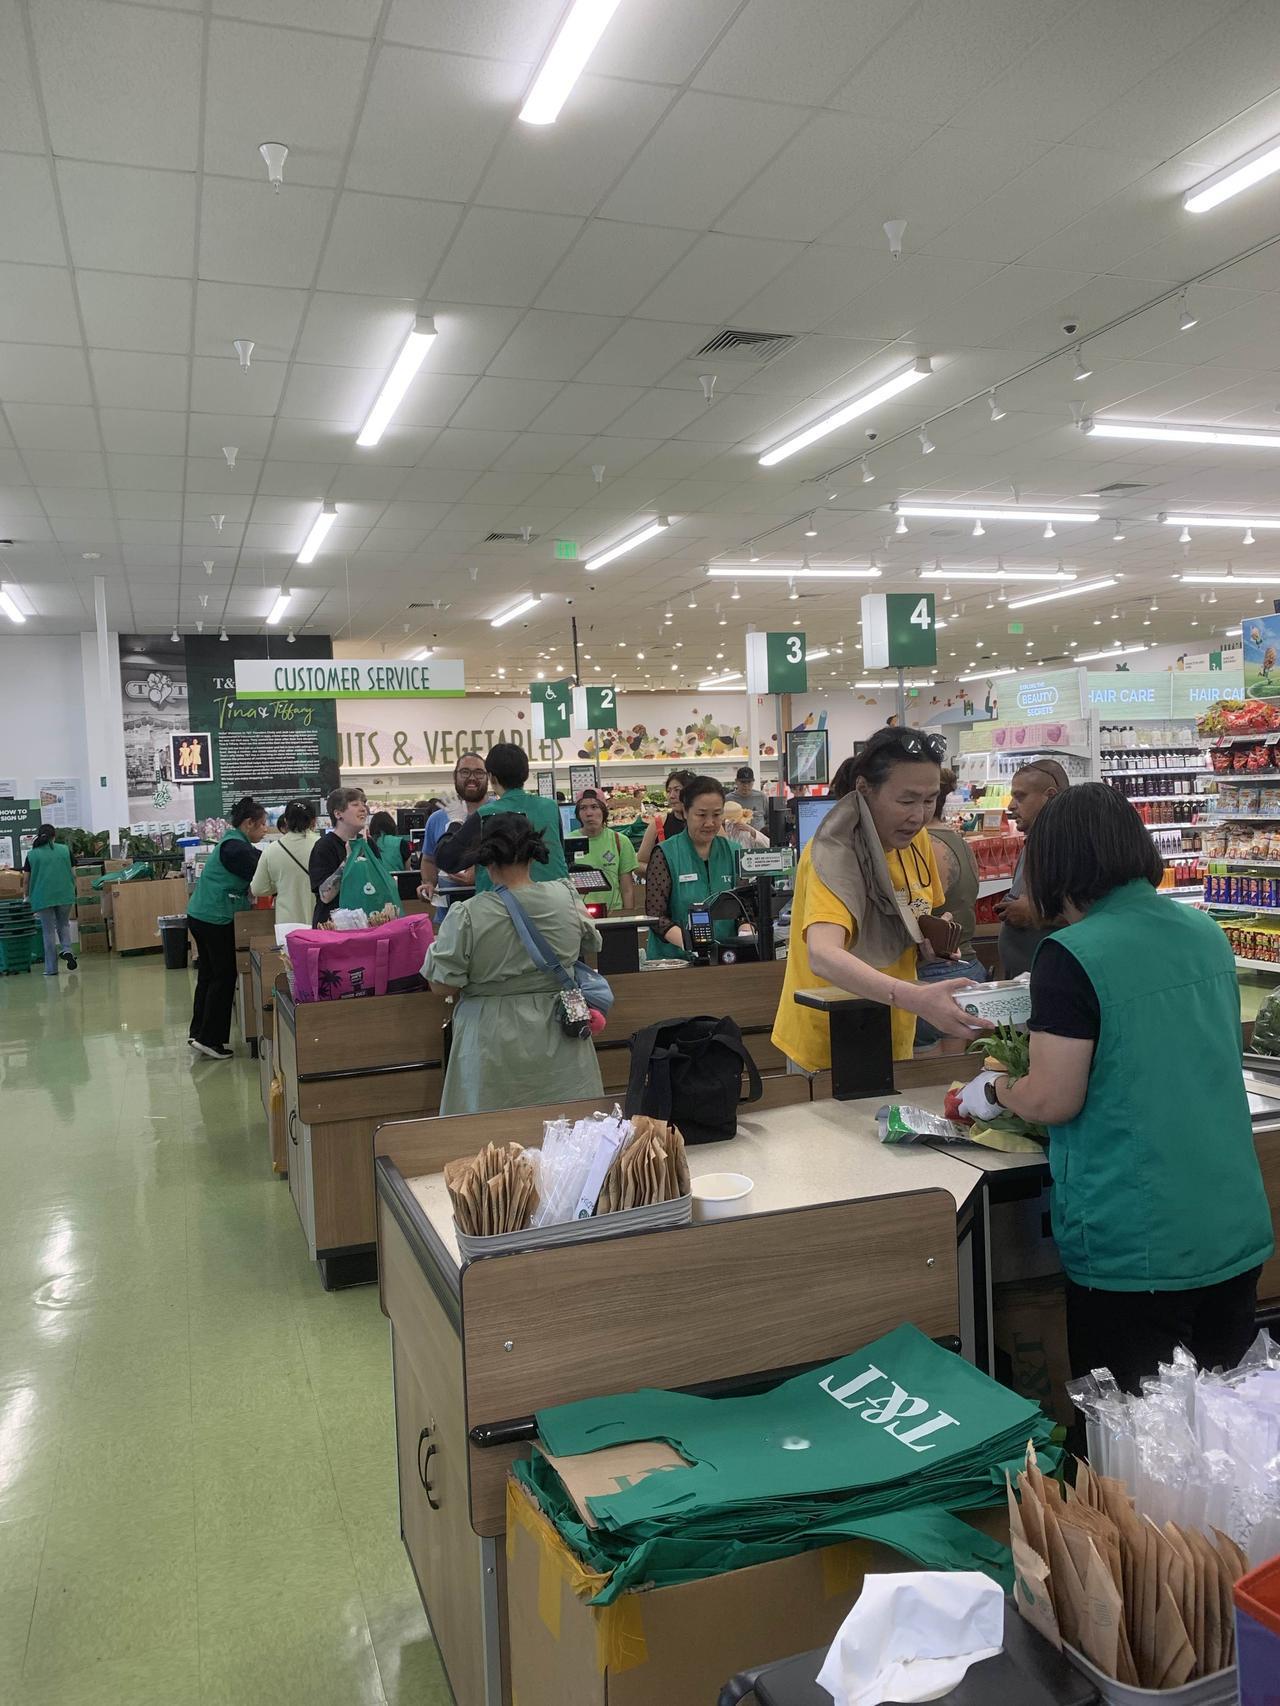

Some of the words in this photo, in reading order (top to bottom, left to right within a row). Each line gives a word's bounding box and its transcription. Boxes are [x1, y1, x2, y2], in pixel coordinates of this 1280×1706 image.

[909, 598, 931, 630] 4
[786, 636, 803, 664] 3
[274, 667, 361, 692] CUSTOMER
[368, 666, 430, 690] SERVICE
[601, 688, 614, 709] 2
[1022, 691, 1053, 705] BEAUTY
[1120, 688, 1155, 702] CARE
[1190, 688, 1219, 700] HAIR
[213, 696, 257, 729] Tina
[269, 700, 315, 727] Tiffany
[557, 702, 567, 720] 1
[392, 730, 413, 766] &
[818, 1364, 961, 1453] T&T
